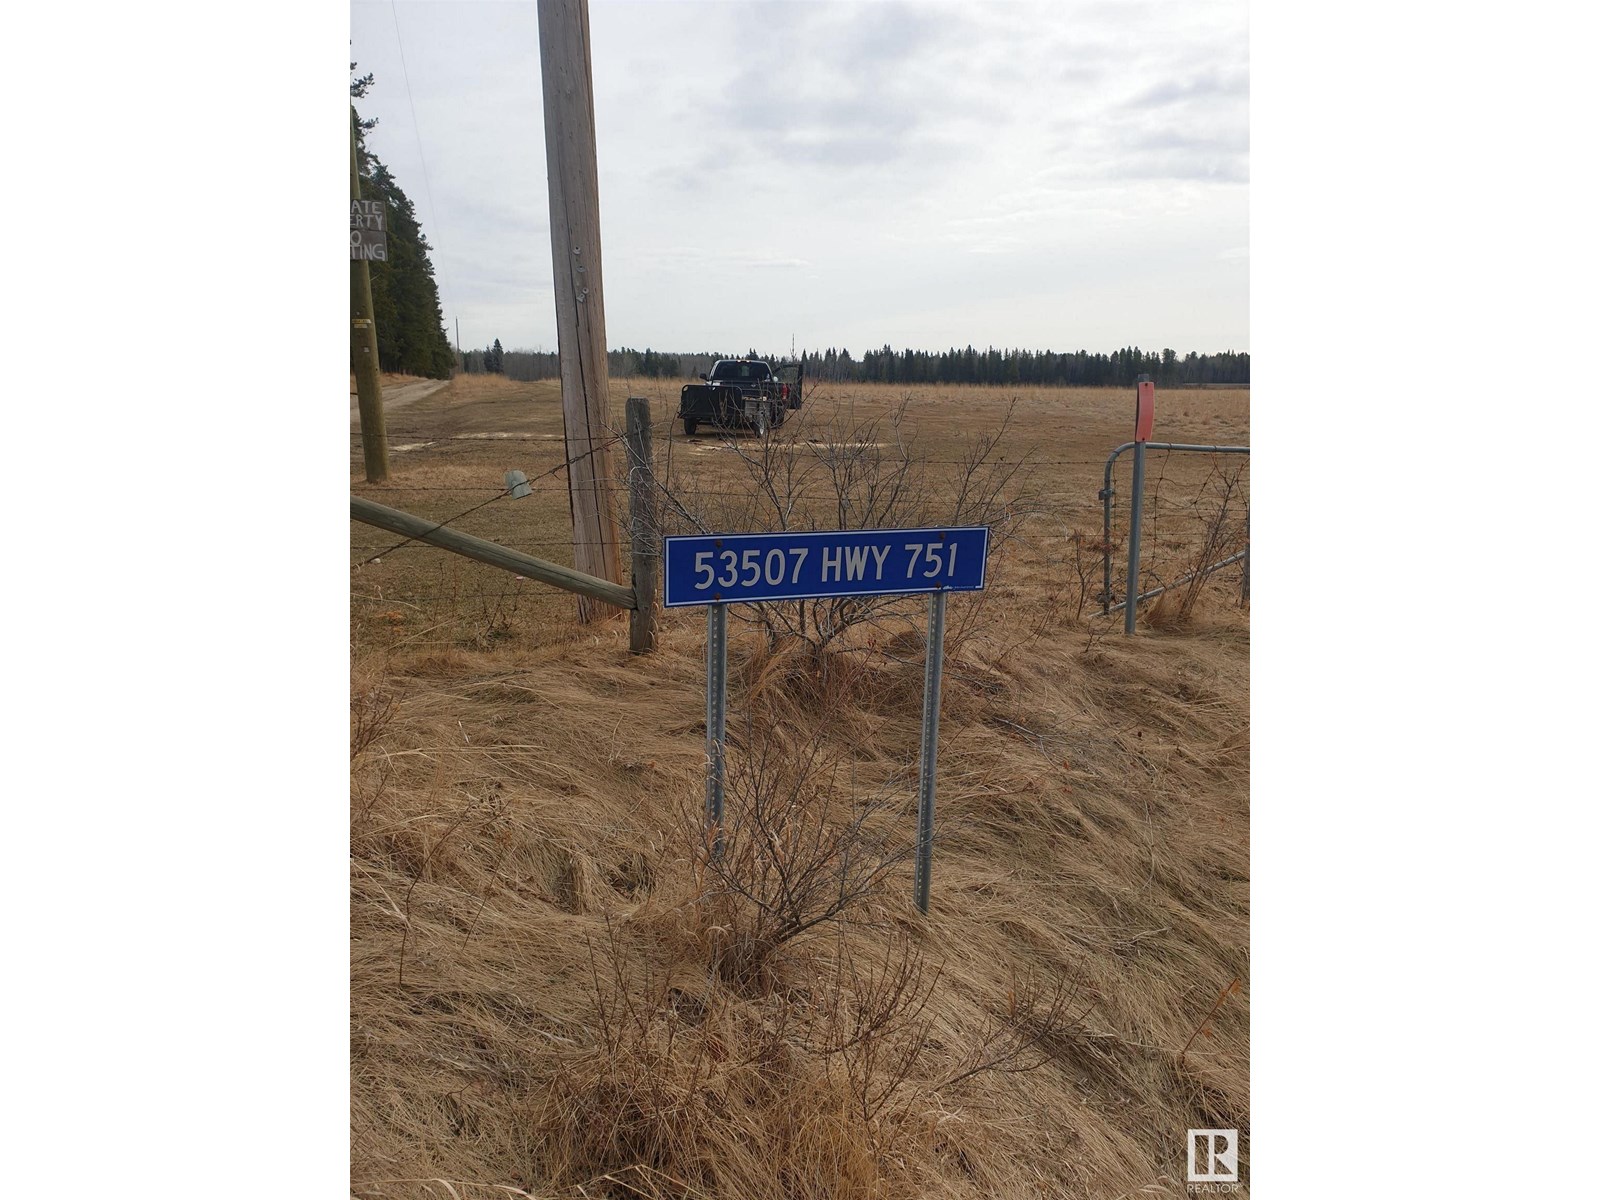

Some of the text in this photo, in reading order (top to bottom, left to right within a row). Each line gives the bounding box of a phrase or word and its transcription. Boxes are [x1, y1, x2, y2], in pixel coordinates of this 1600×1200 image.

[351, 200, 382, 214] ATE
[694, 542, 958, 590] 53507 HWY 751
